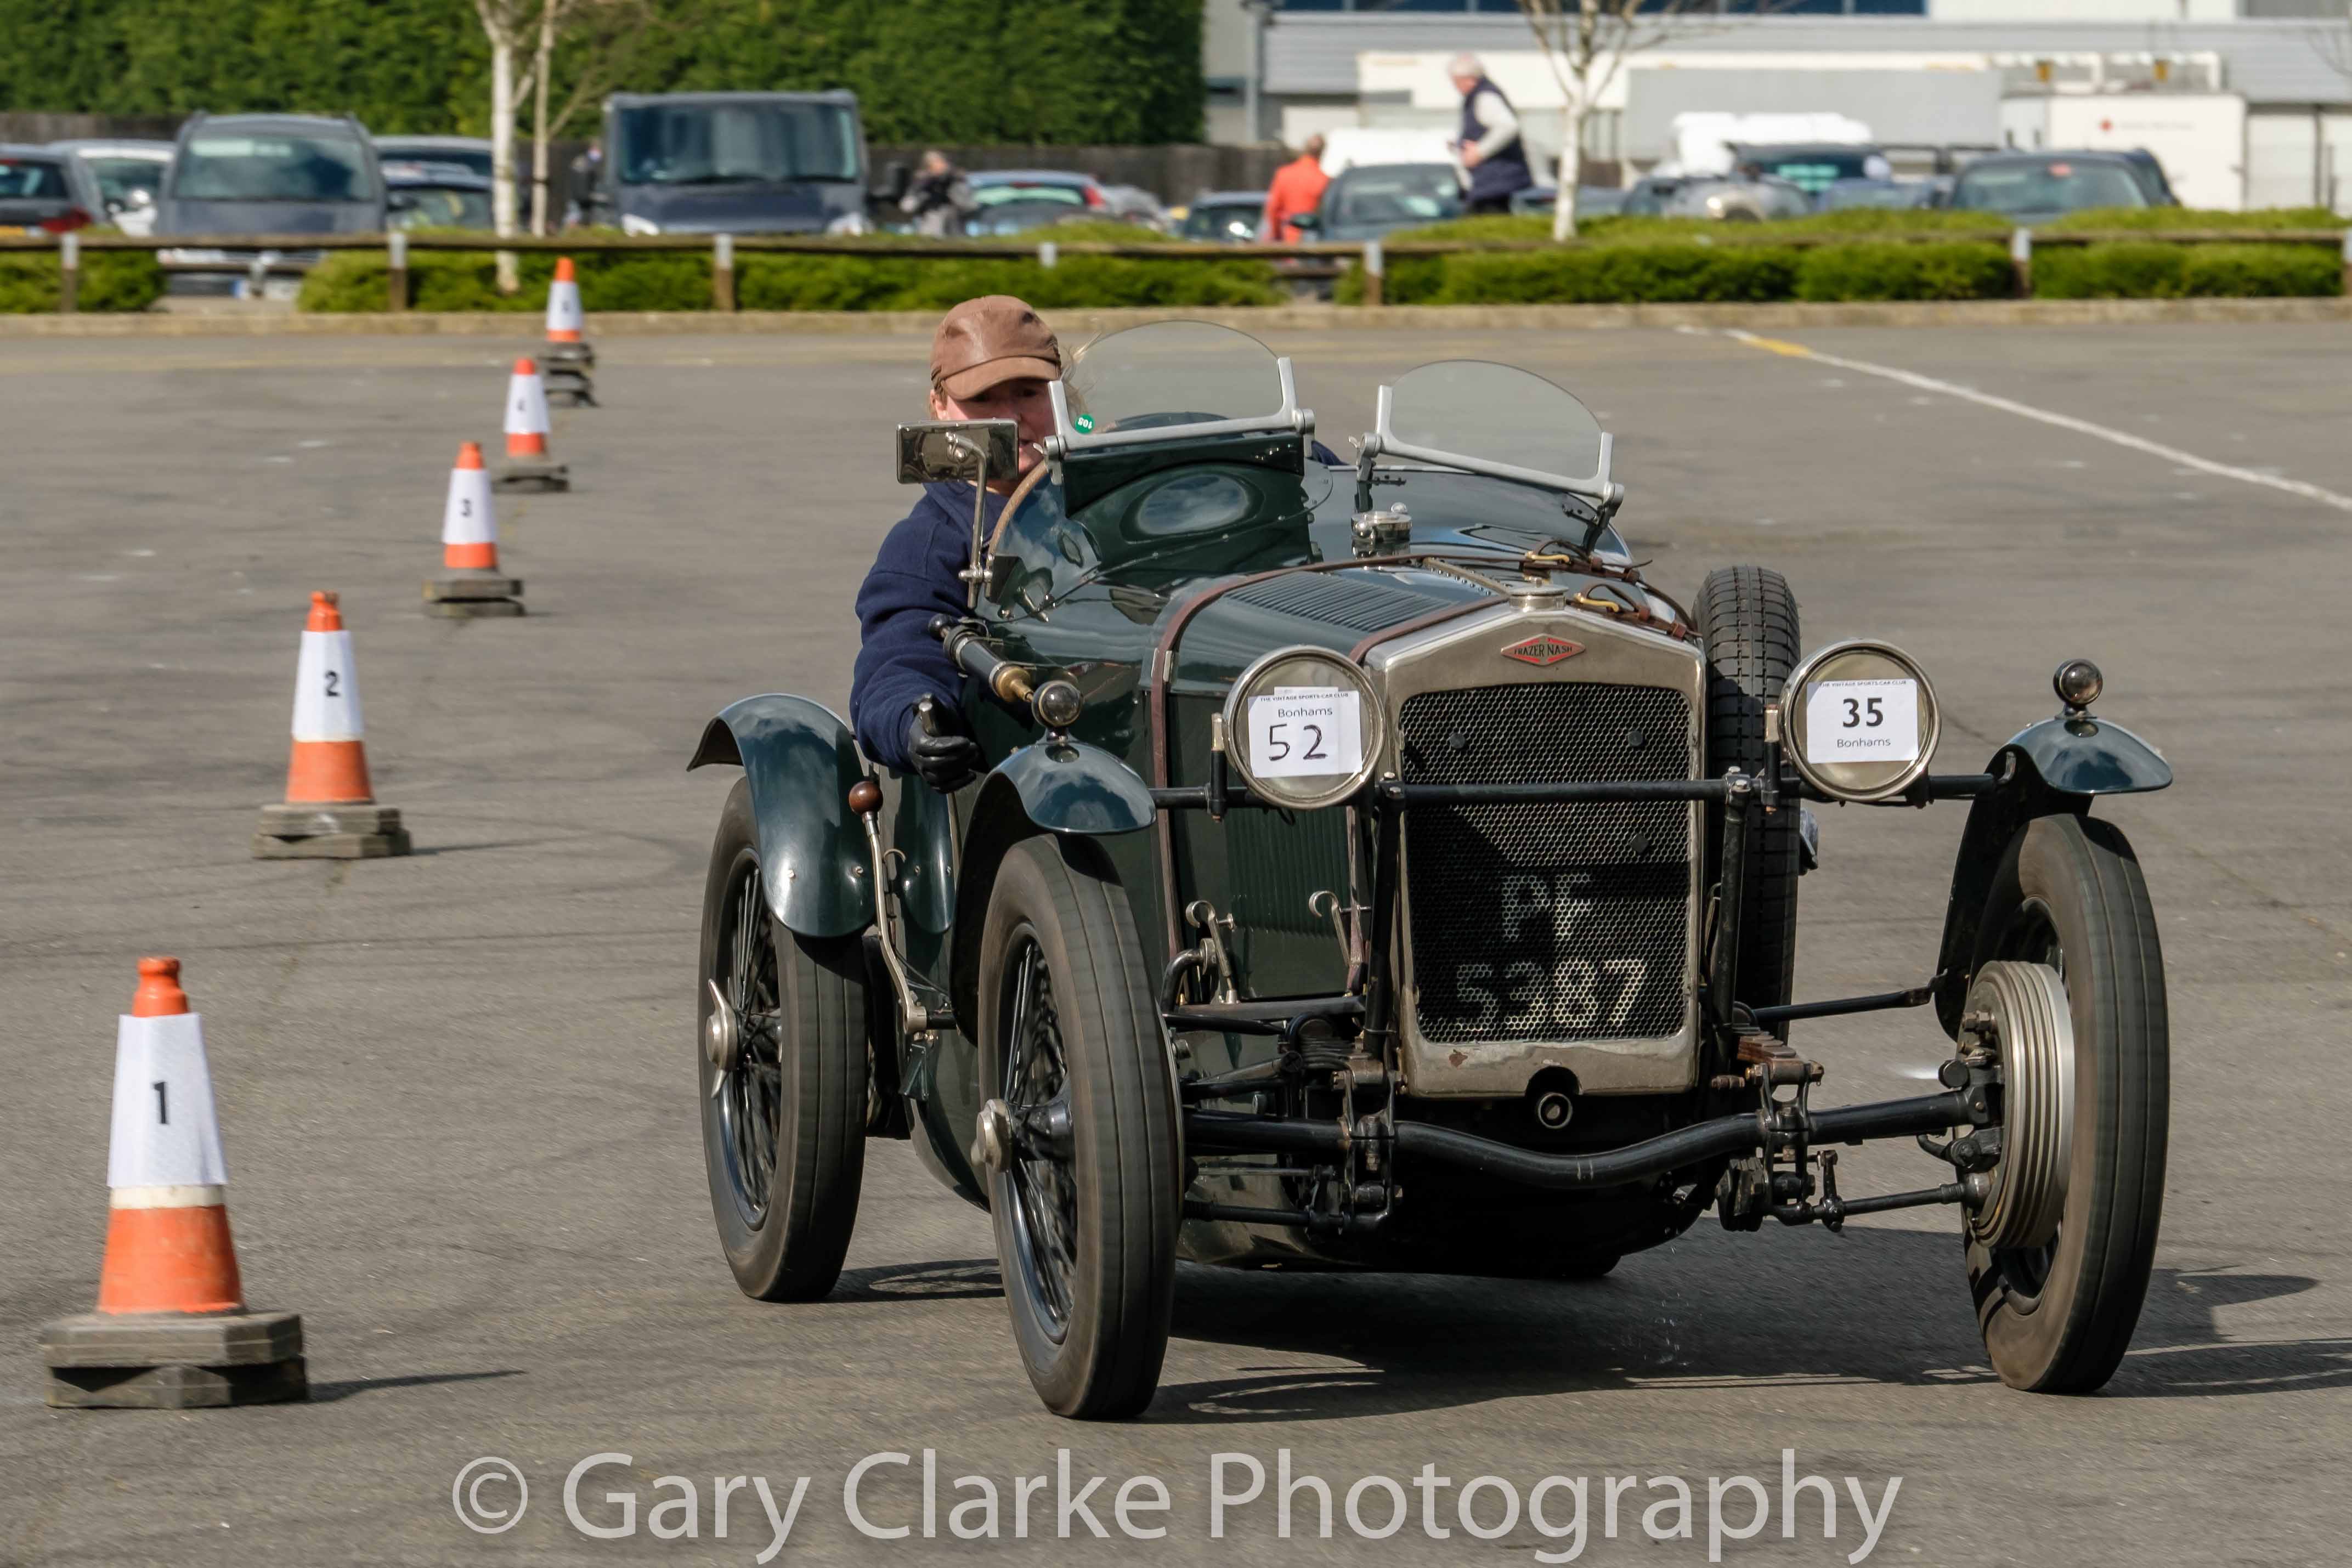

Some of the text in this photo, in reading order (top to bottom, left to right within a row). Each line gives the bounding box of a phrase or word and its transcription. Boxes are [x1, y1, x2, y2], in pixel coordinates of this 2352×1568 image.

[1514, 644, 1573, 657] FRAZER NASH
[325, 670, 341, 697] 2
[1279, 706, 1333, 717] Bonhams
[1843, 698, 1883, 727] 35
[1269, 723, 1328, 761] 52
[1837, 738, 1891, 748] Bonhams
[1502, 874, 1591, 941] PF
[1457, 958, 1646, 1032] 5387
[152, 1081, 169, 1124] 1
